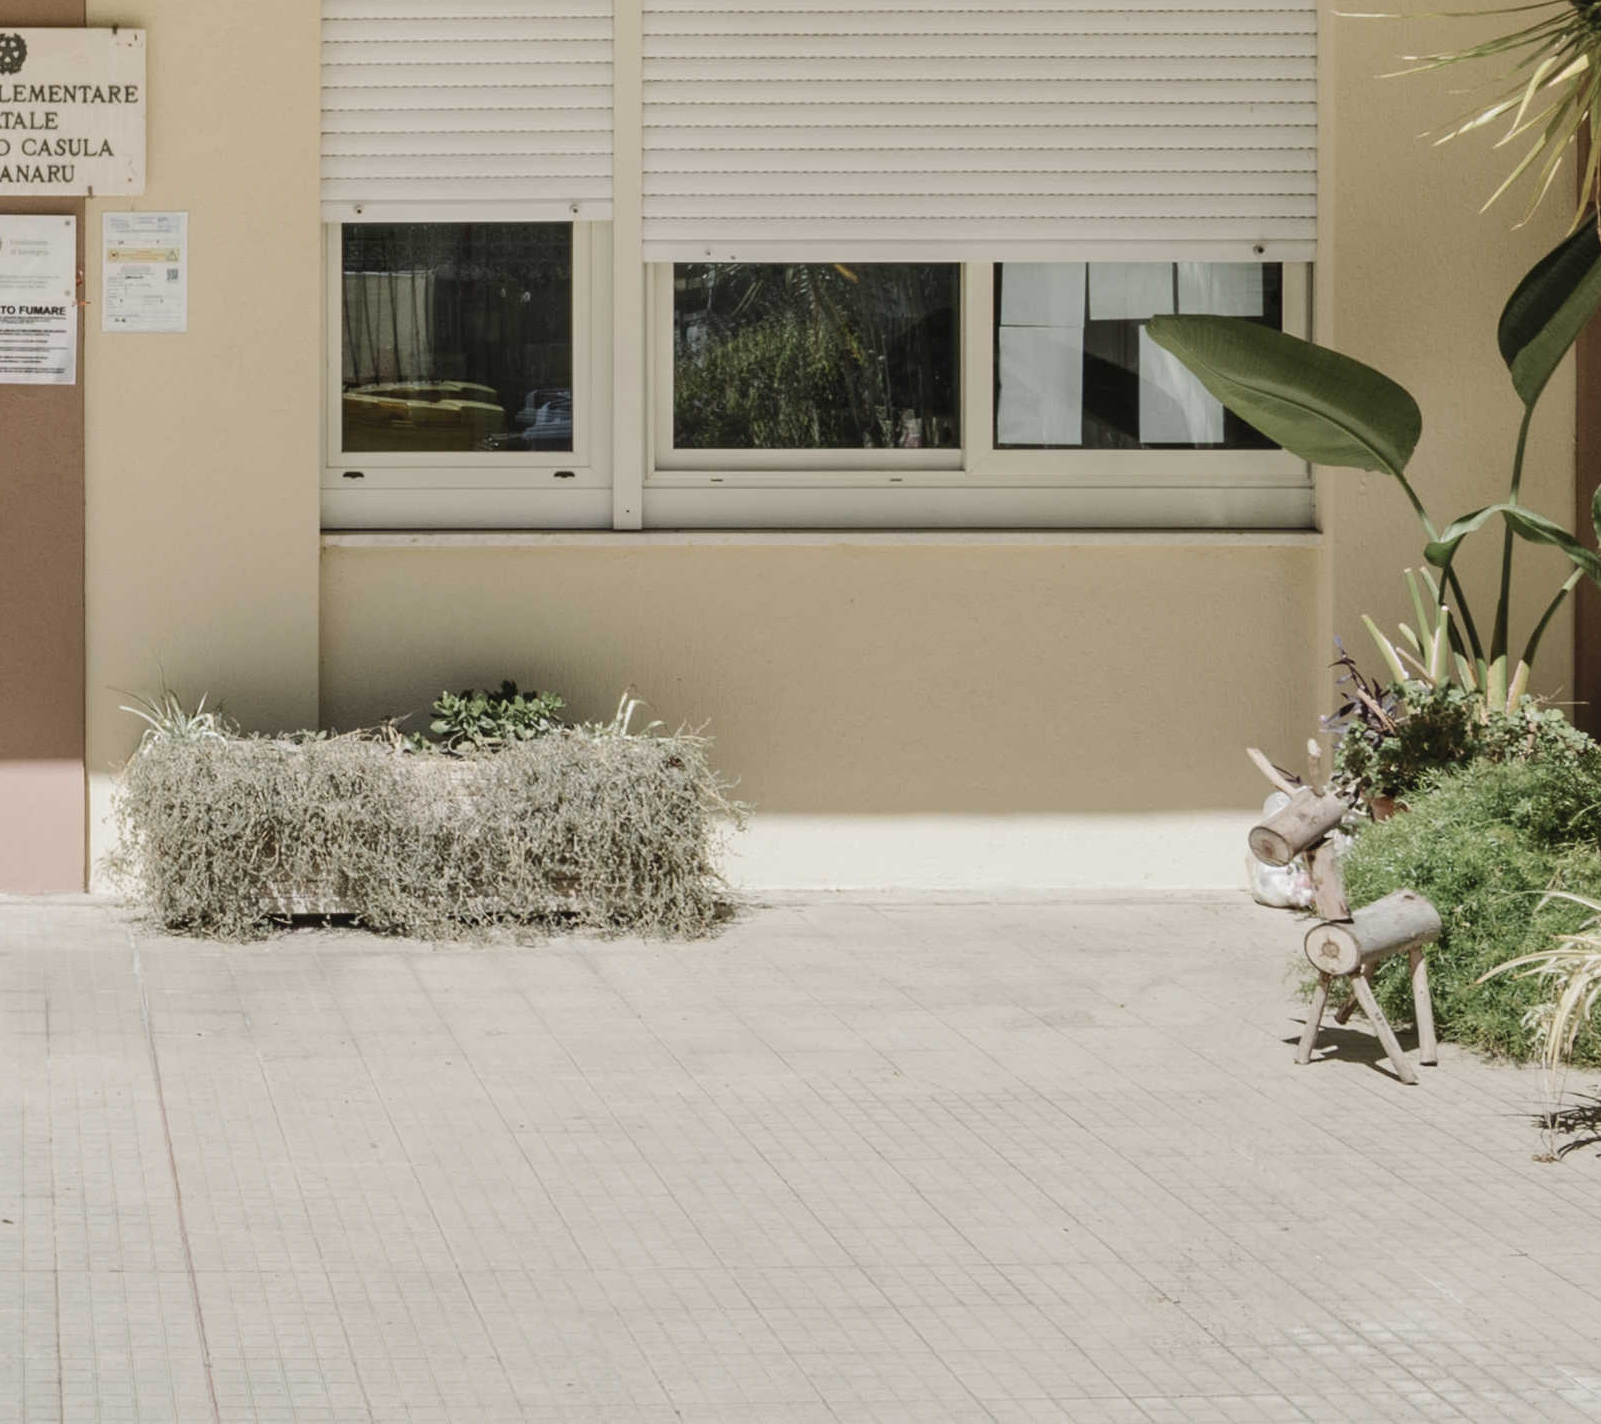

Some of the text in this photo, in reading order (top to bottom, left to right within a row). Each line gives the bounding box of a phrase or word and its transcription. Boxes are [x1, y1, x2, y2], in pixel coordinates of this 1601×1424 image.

[22, 139, 114, 157] CASULA
[18, 249, 48, 257] Sardegna
[19, 306, 66, 315] FUMARE
